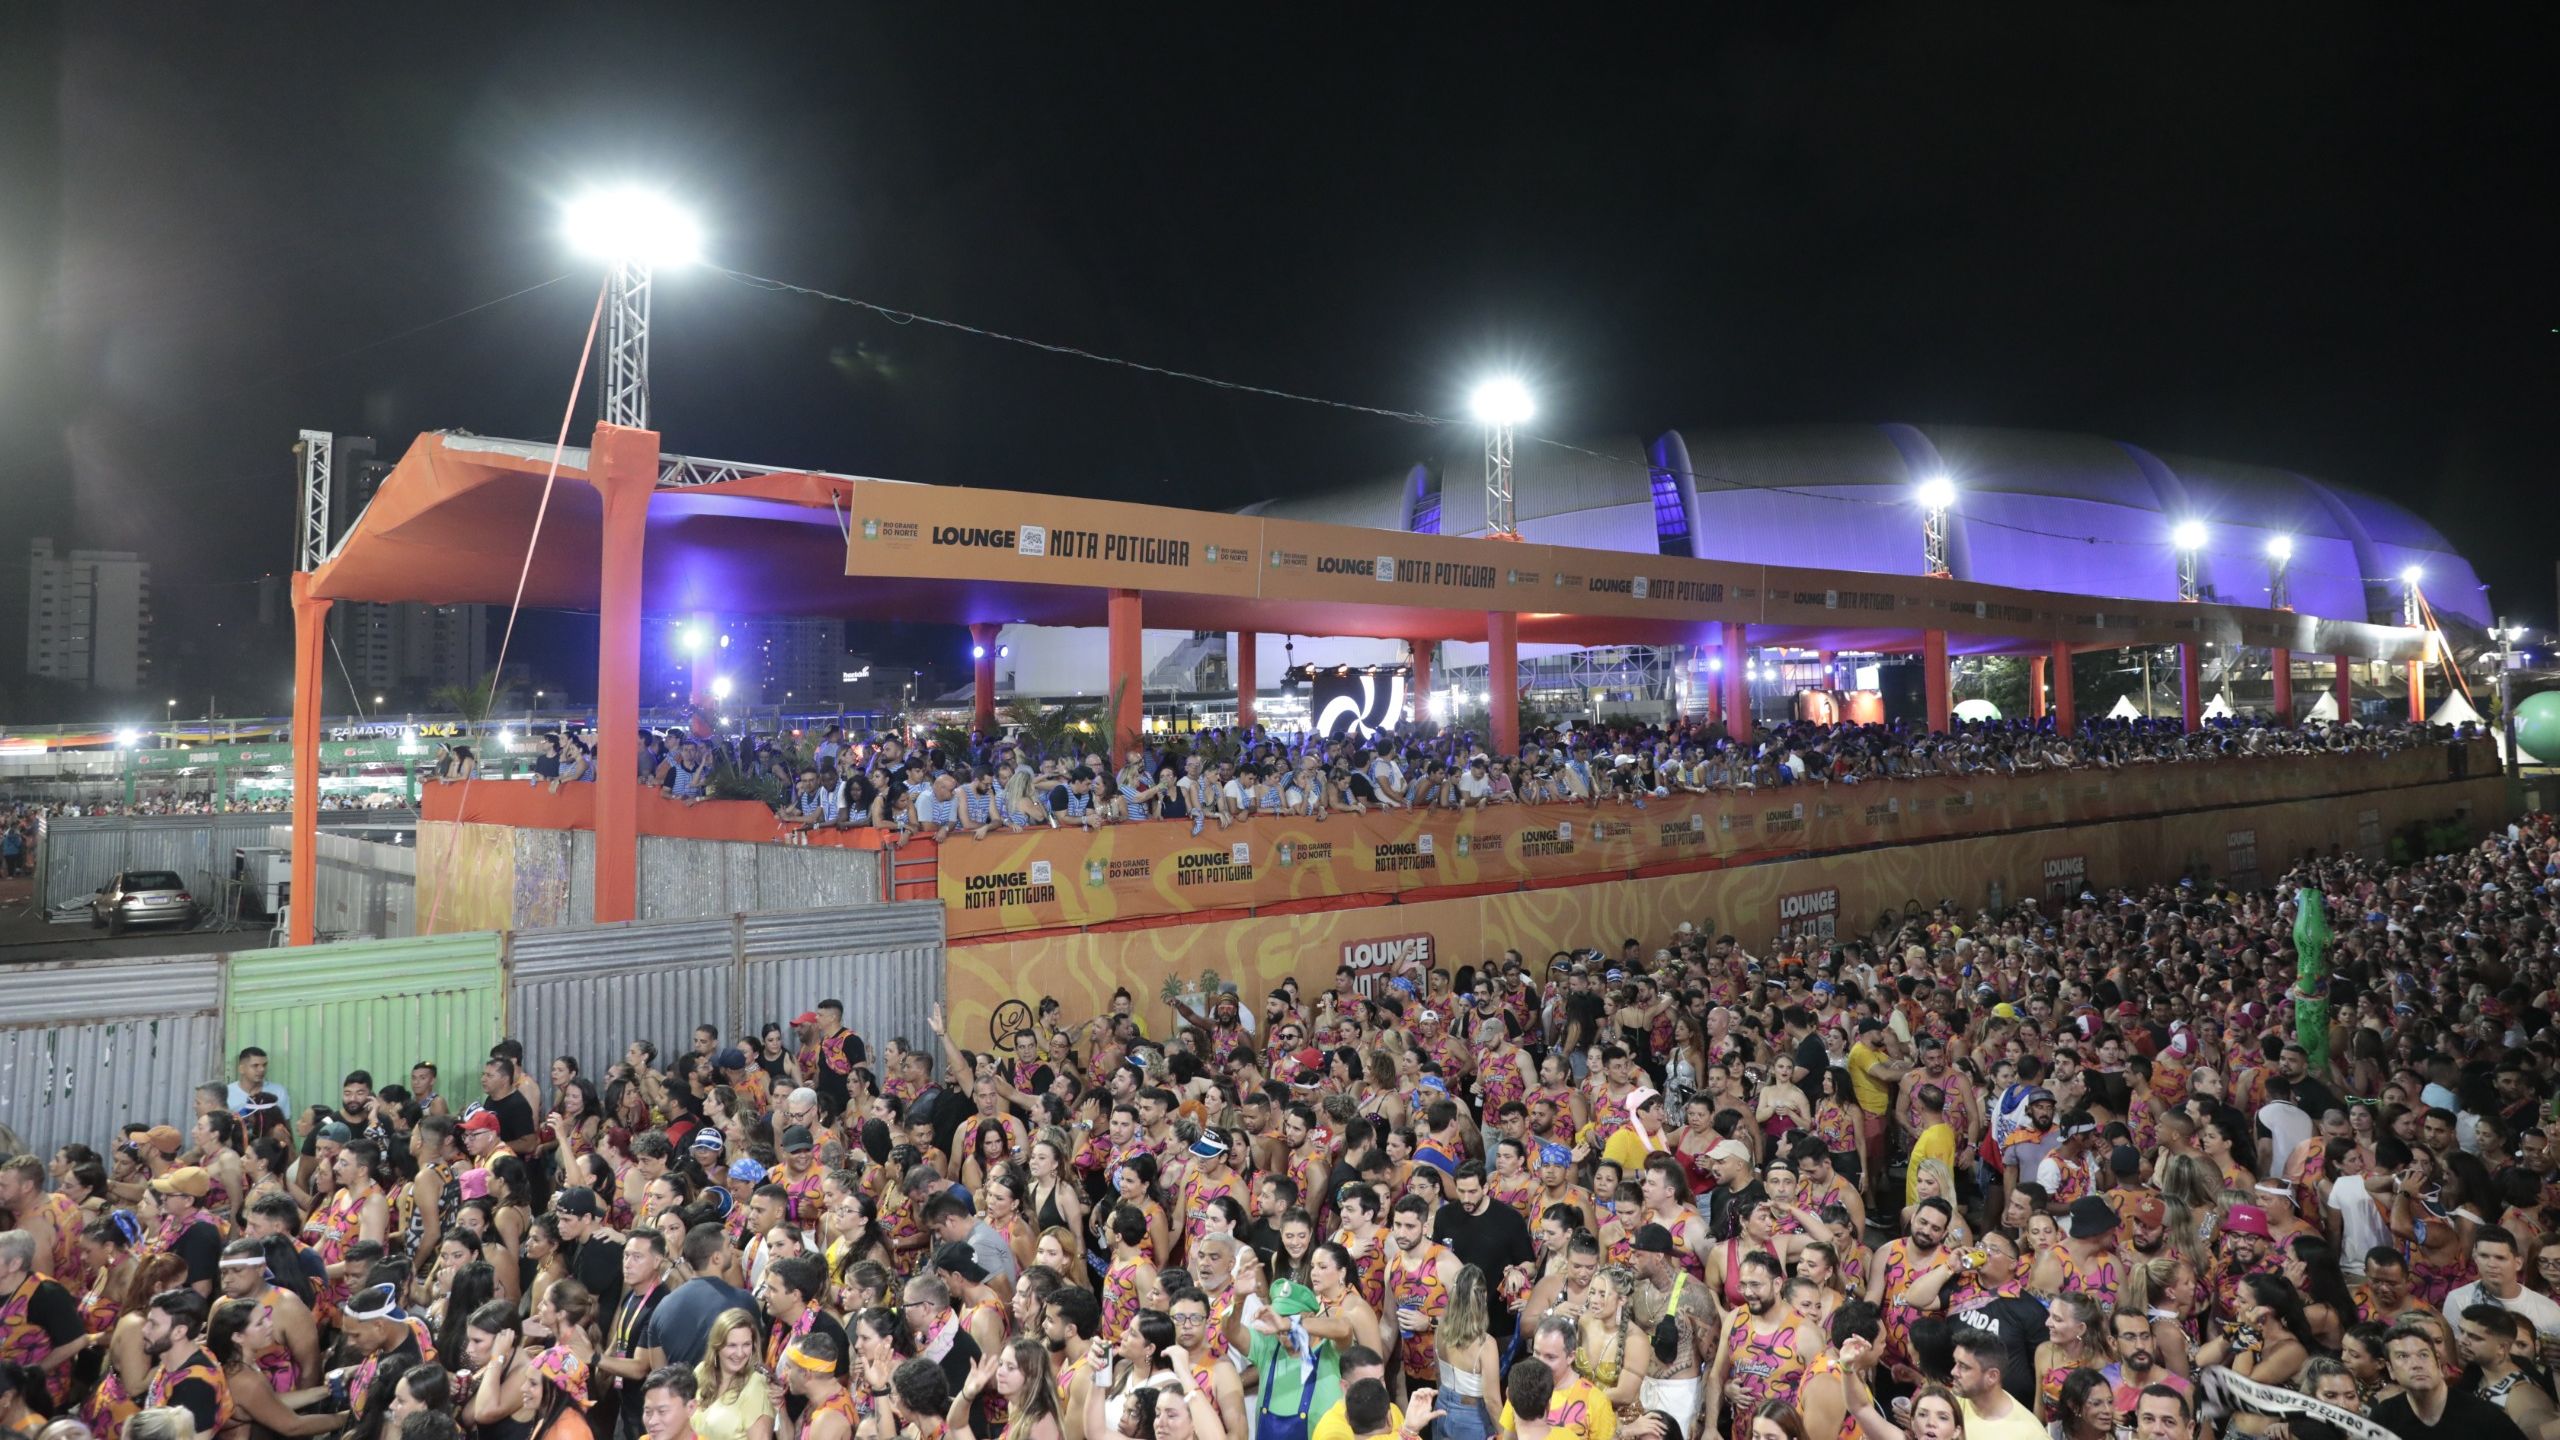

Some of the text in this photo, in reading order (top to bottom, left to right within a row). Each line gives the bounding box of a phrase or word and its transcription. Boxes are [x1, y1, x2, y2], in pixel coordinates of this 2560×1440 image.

[883, 528, 918, 537] DO NORTE
[894, 522, 919, 530] GRANDE
[932, 526, 1189, 567] LOUNGE NOTA POTIGUAR
[1230, 548, 1248, 556] GRANDE
[1220, 553, 1248, 562] DO NORTE
[1317, 557, 1496, 589] LOUNGE NOTA POTIGUAR
[1589, 578, 1632, 594] LOUNGE
[1649, 579, 1675, 600] NOTA
[1677, 581, 1723, 602] POTIGUAR
[1794, 592, 1826, 605] LOUNGE
[1766, 810, 1794, 821] LOUNGE
[1661, 822, 1691, 834] LOUNGE
[1522, 830, 1558, 843] LOUNGE
[1308, 842, 1332, 850] GRANDE
[1375, 843, 1417, 857] LOUNGE
[1482, 841, 1502, 850] NORTE
[1522, 841, 1574, 857] NOTA POTIGUAR
[1178, 852, 1230, 869] LOUNGE
[1297, 850, 1332, 860] DO NORTE
[1109, 859, 1150, 869] RIO GRANDE
[1375, 855, 1435, 872] NOTA POTIGUAR
[2044, 856, 2084, 878] LOUNGE
[1109, 867, 1150, 878] DO NORTE
[1178, 865, 1253, 886] NOTA POTIGUAR
[965, 872, 1027, 891] LOUNGE
[965, 885, 1055, 910] NOTA POTIGUAR
[1780, 890, 1836, 919] LOUNGE
[1344, 937, 1429, 969] LOUNGE
